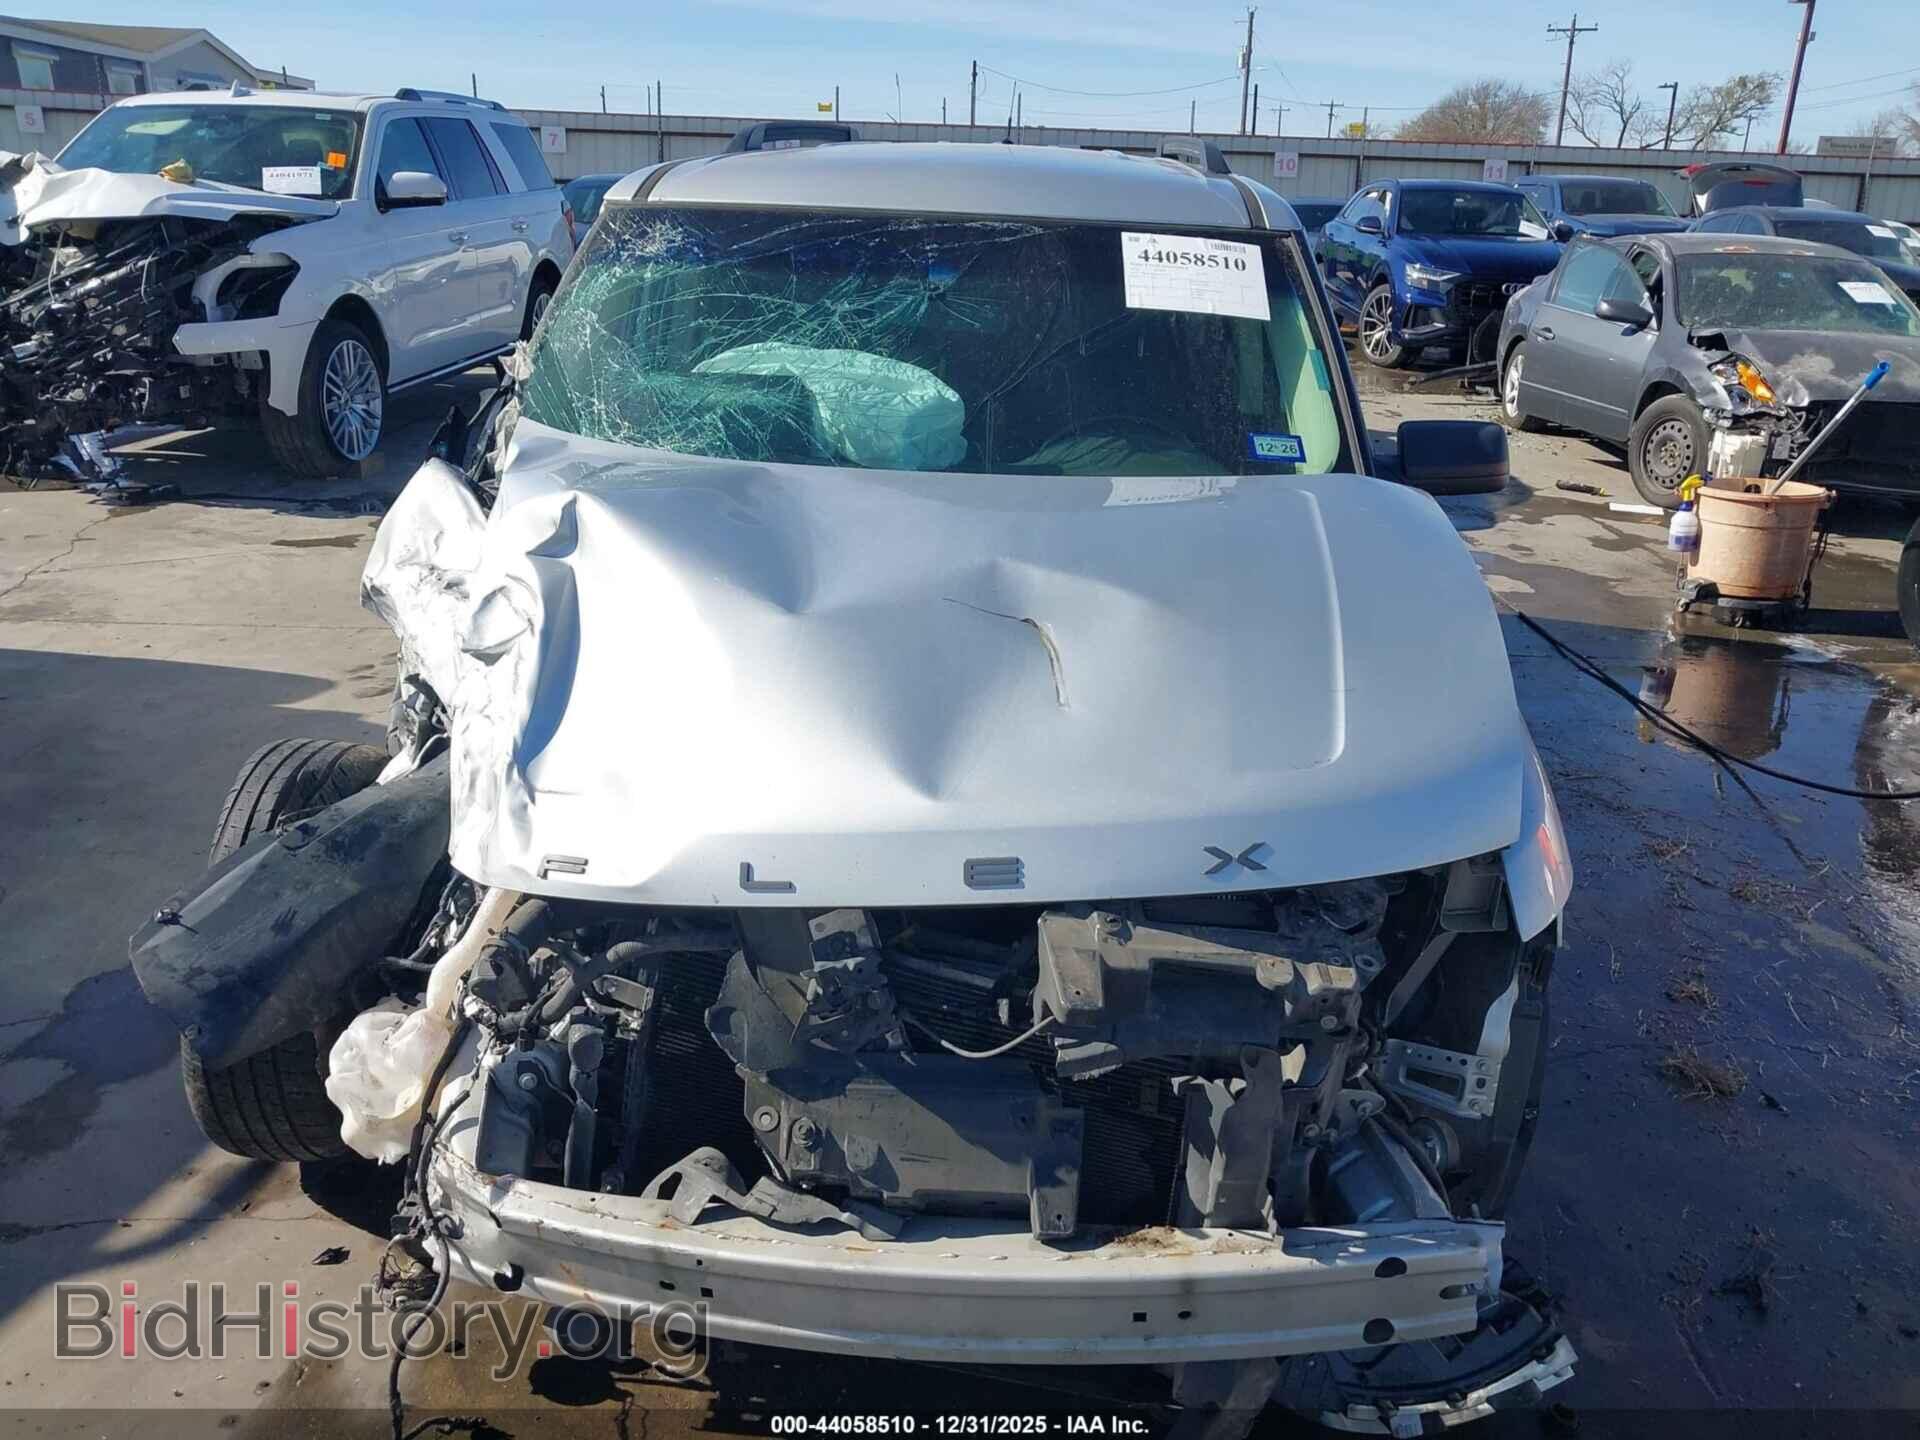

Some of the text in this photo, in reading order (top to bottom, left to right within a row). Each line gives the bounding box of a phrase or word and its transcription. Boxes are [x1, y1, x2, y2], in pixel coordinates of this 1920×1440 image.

[549, 132, 558, 146] 7
[1275, 158, 1296, 171] 10
[1138, 249, 1247, 271] 44058510
[1258, 443, 1297, 454] 12 26
